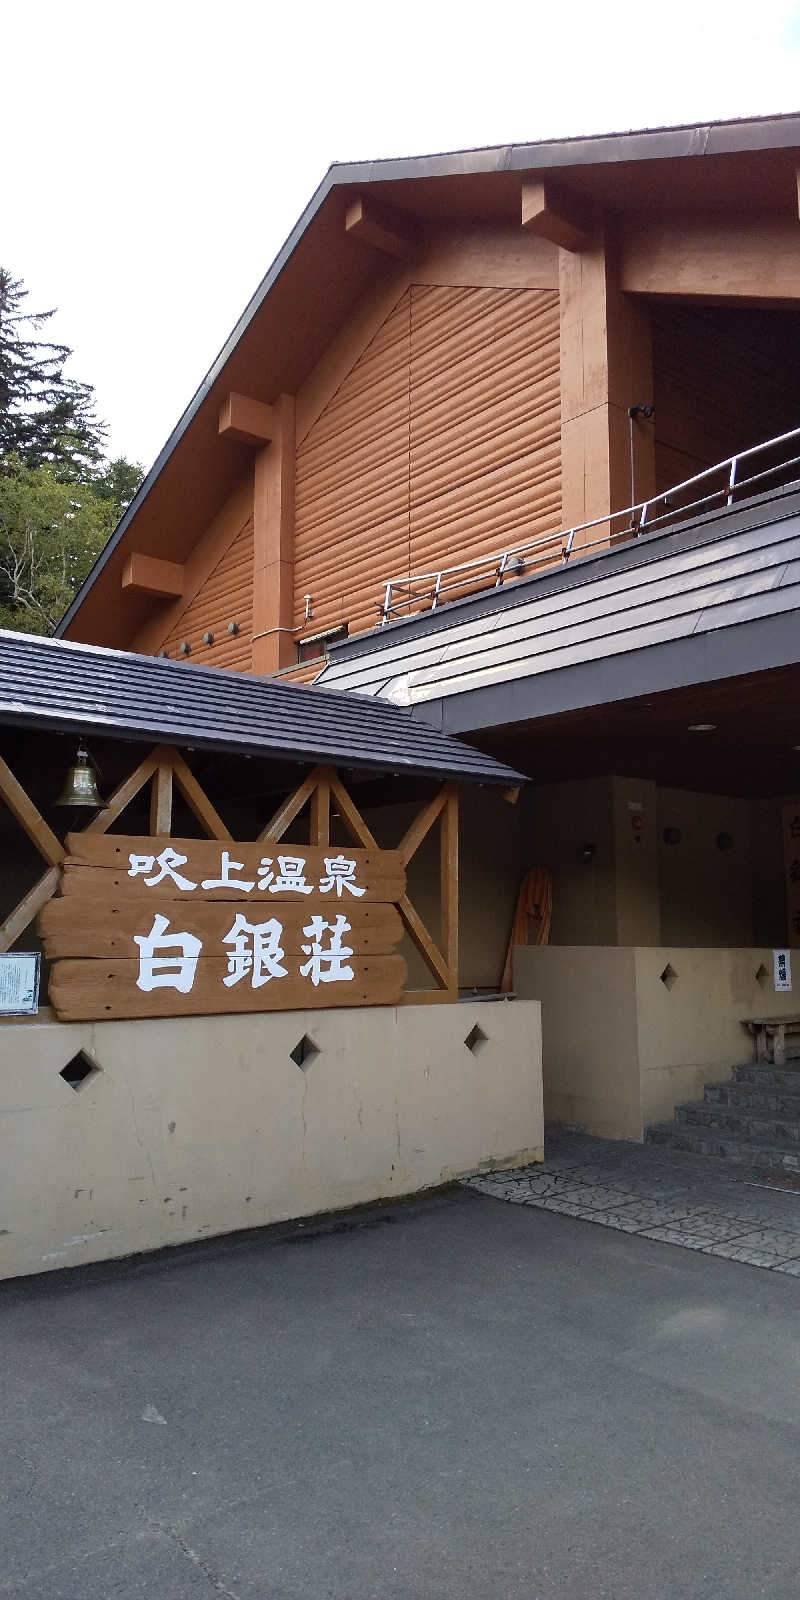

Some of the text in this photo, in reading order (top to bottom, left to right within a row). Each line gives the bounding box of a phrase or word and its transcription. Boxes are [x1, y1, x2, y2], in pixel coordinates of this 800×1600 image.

[127, 847, 366, 898] 吹上温泉
[133, 913, 355, 993] 白銀荘
